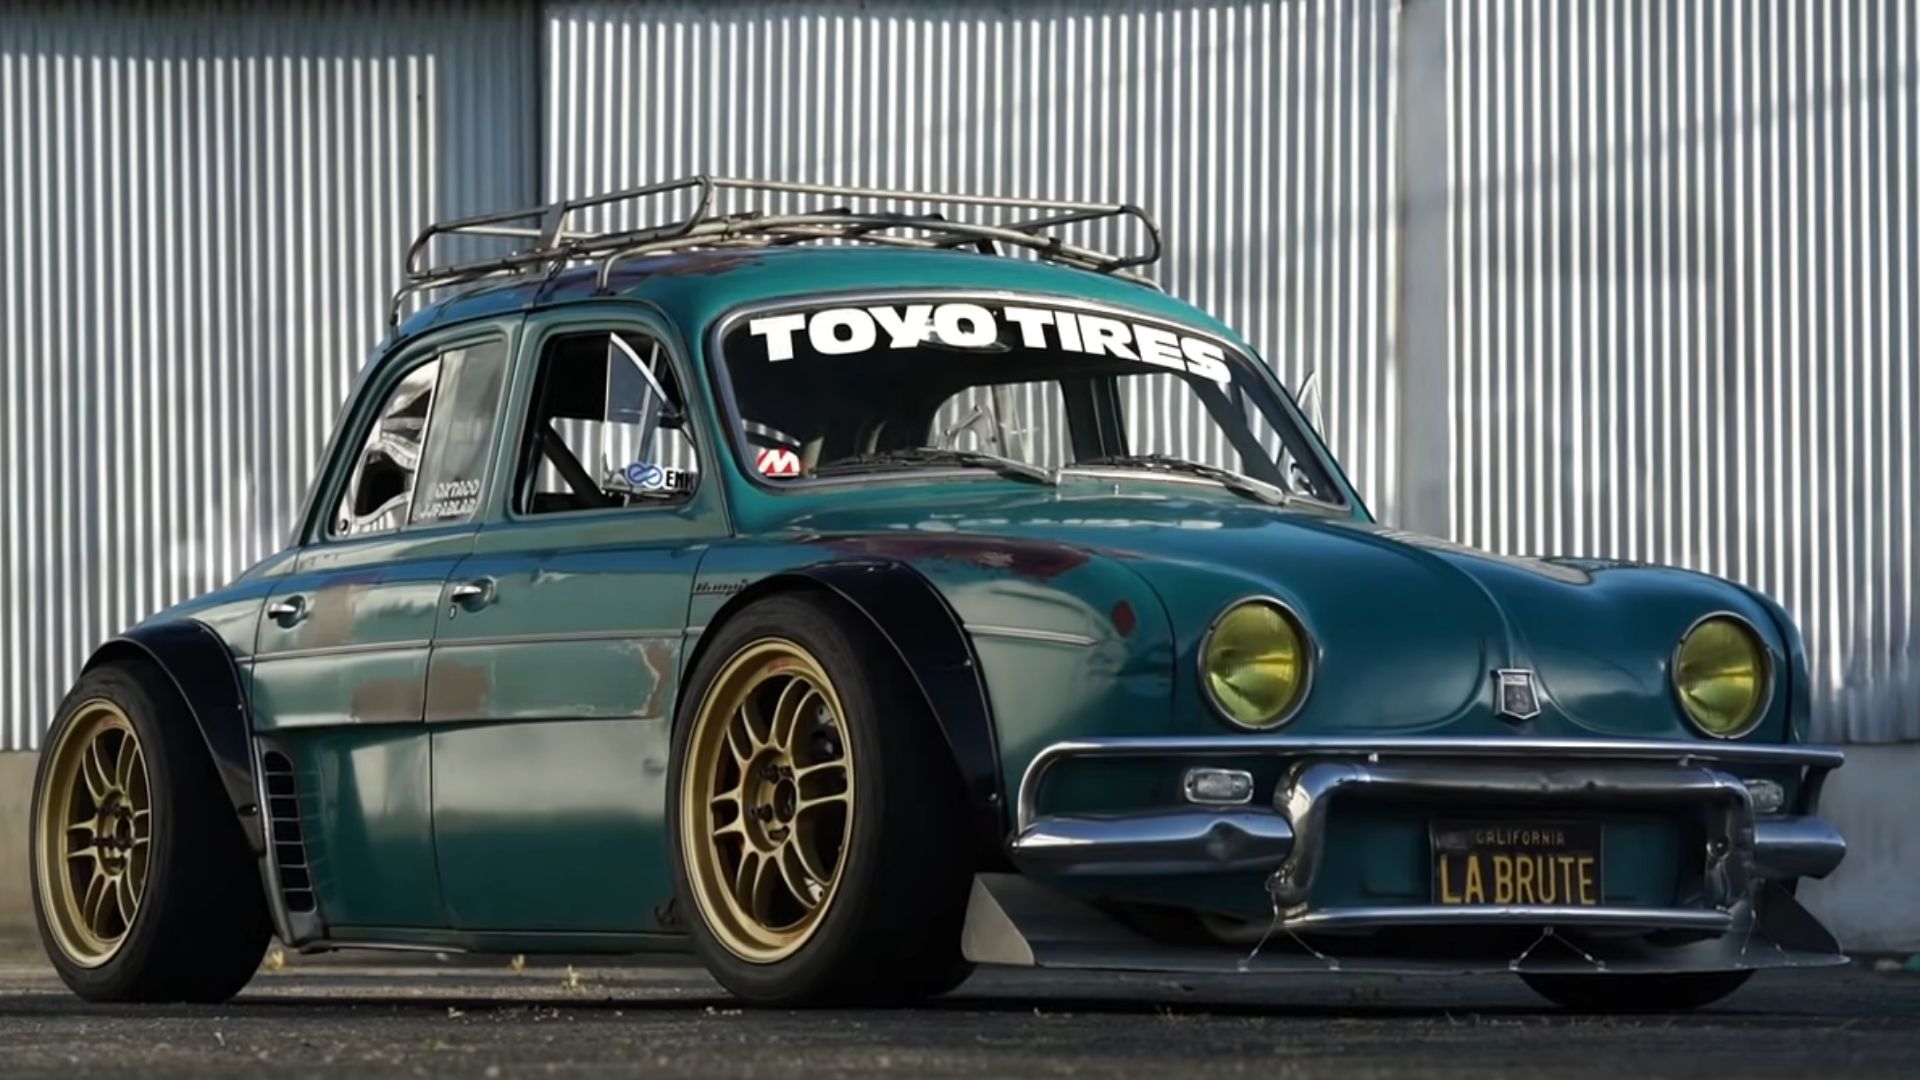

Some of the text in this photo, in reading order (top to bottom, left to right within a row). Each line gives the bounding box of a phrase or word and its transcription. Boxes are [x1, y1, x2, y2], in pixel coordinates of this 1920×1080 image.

[750, 304, 1232, 383] TOYO TIRES
[1475, 830, 1565, 846] CALIFORNIA
[1440, 855, 1596, 906] LA BRUTE
